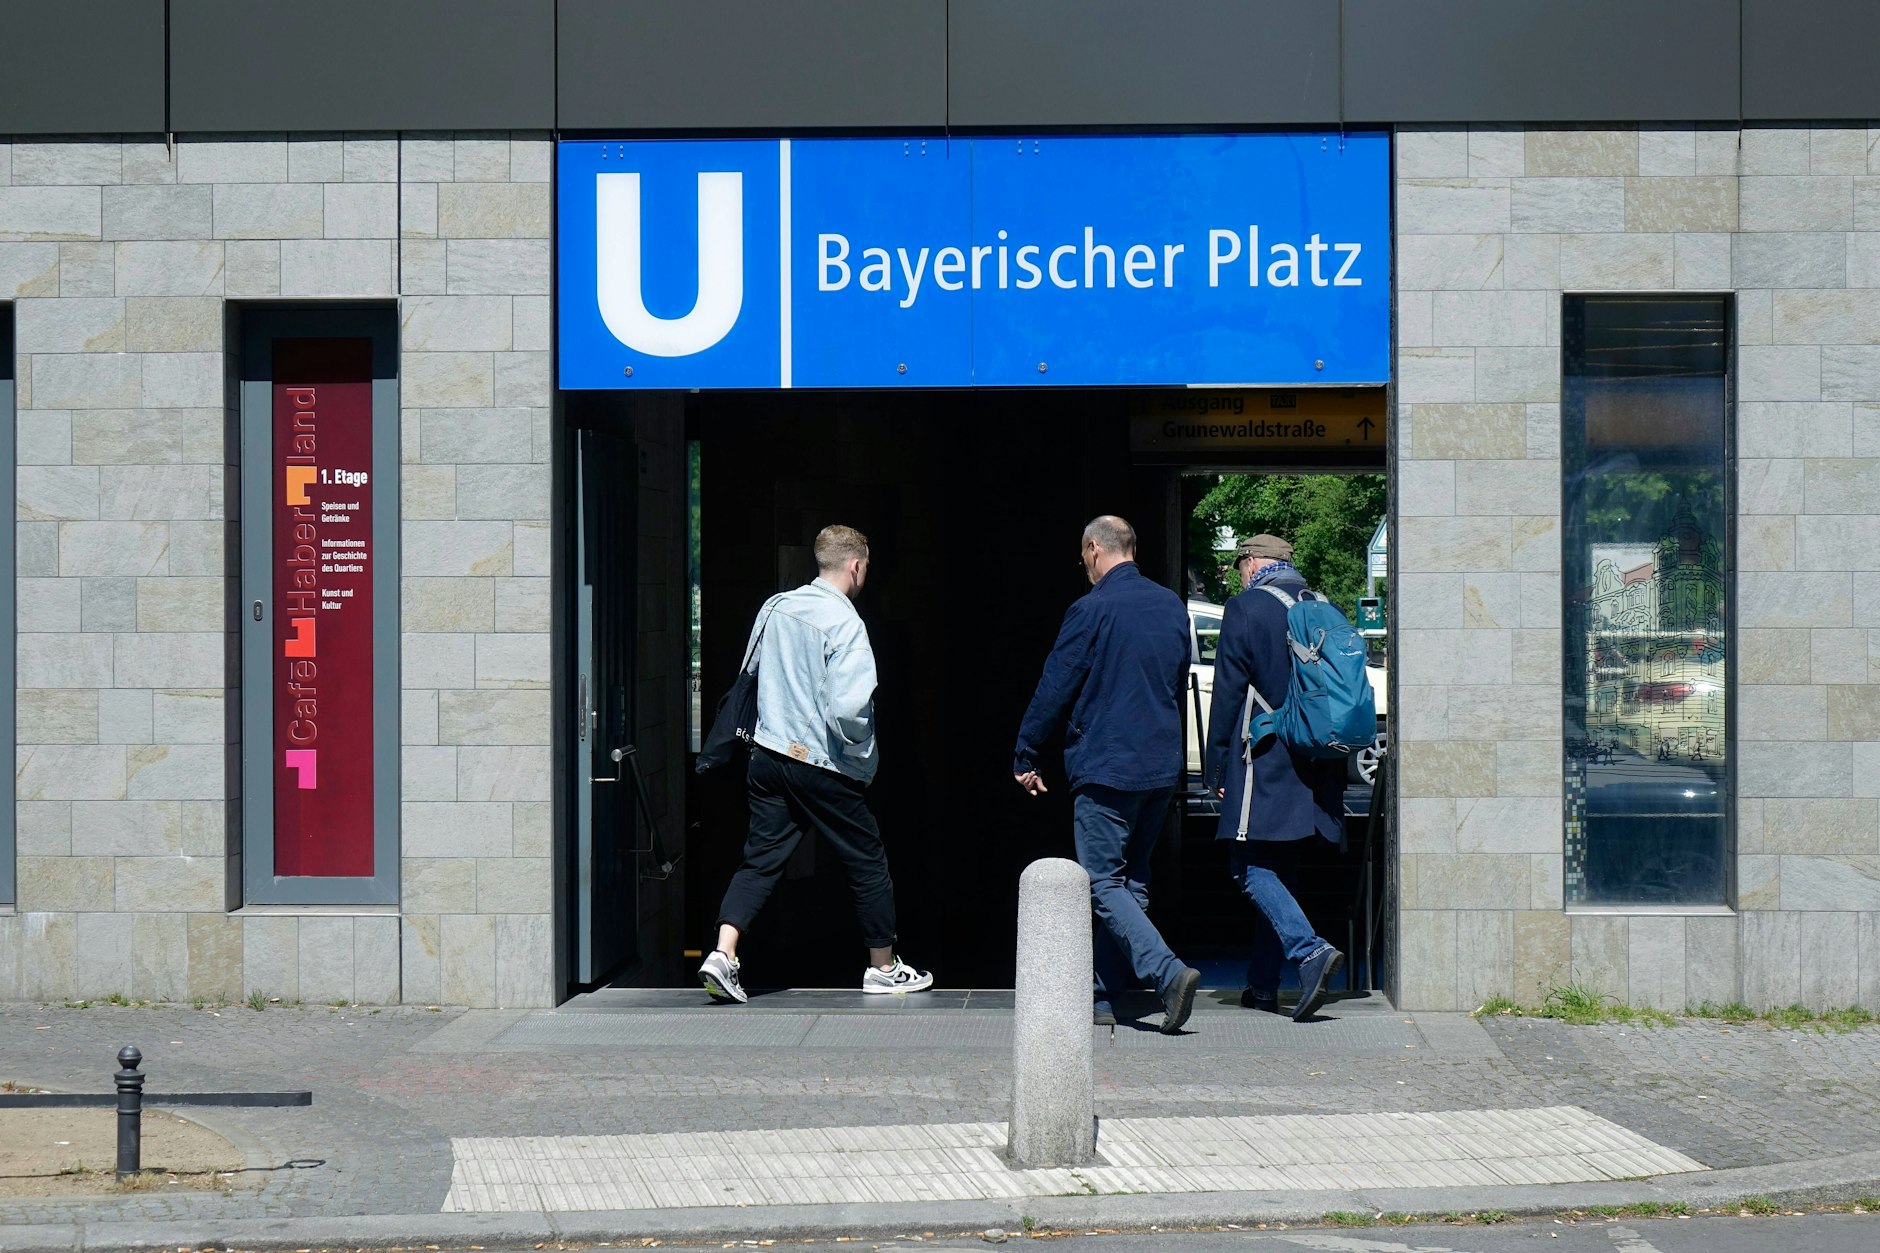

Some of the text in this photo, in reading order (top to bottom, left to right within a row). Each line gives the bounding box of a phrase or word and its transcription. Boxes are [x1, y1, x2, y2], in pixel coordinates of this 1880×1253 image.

[596, 172, 743, 357] U
[817, 225, 1364, 308] Bayerischer Platz
[1161, 394, 1245, 415] Ausgang
[1162, 420, 1326, 438] Grunewaldstraße
[321, 469, 368, 487] 1. Etage
[321, 502, 359, 511] Speisen und
[321, 514, 350, 522] Getränke
[321, 539, 365, 547] Informationen
[321, 551, 367, 560] zur Geschichte
[321, 564, 363, 572] des Quartiers
[321, 589, 354, 597] Kunst und
[321, 601, 342, 609] Kultur
